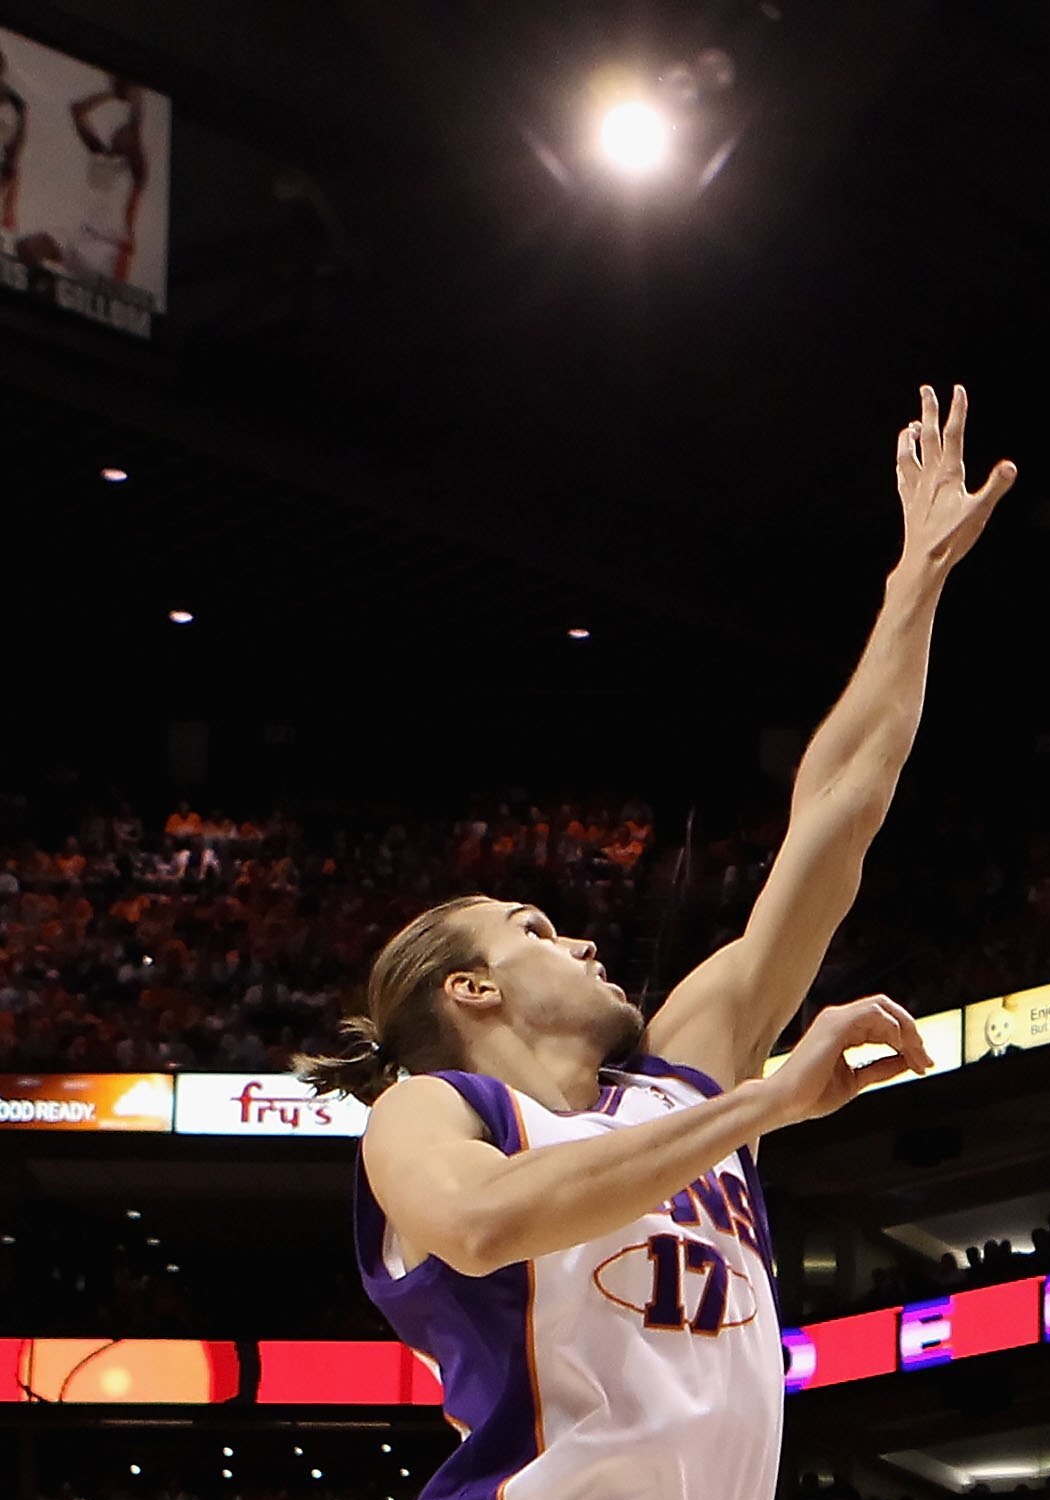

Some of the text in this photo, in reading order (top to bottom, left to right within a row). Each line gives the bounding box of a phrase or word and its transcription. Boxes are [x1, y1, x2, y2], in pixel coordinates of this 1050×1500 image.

[1030, 1021, 1048, 1037] But
[231, 1082, 332, 1128] fry's
[643, 1232, 730, 1338] 17
